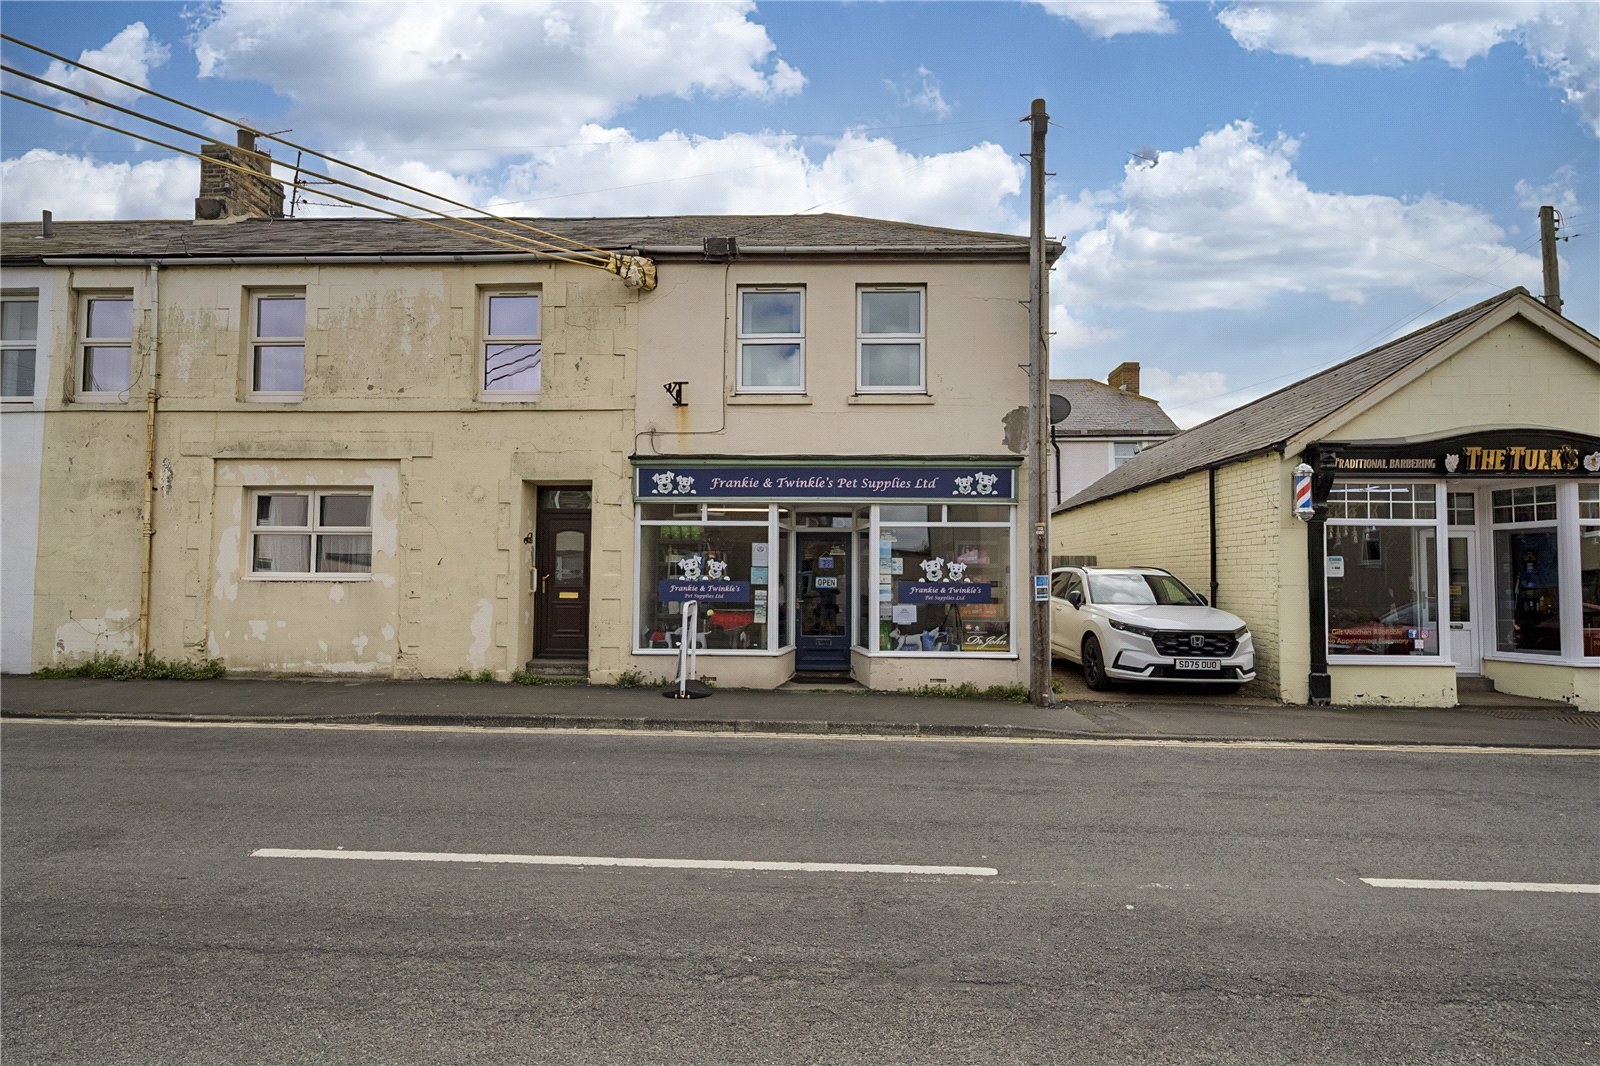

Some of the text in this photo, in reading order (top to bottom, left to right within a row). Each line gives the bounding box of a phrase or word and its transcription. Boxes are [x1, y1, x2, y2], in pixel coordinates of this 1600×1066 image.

[1335, 457, 1436, 469] TRADITIONAL BARBERING
[1463, 446, 1506, 471] THE
[710, 477, 939, 492] Frankie & Twinkle's Pet Supplies Ltd
[669, 584, 698, 592] Frankie
[707, 584, 740, 592] Twinkle's
[909, 586, 939, 595] Frankie
[948, 586, 982, 594] Twinkle's
[977, 634, 1007, 650] John
[1179, 660, 1200, 669] SD75
